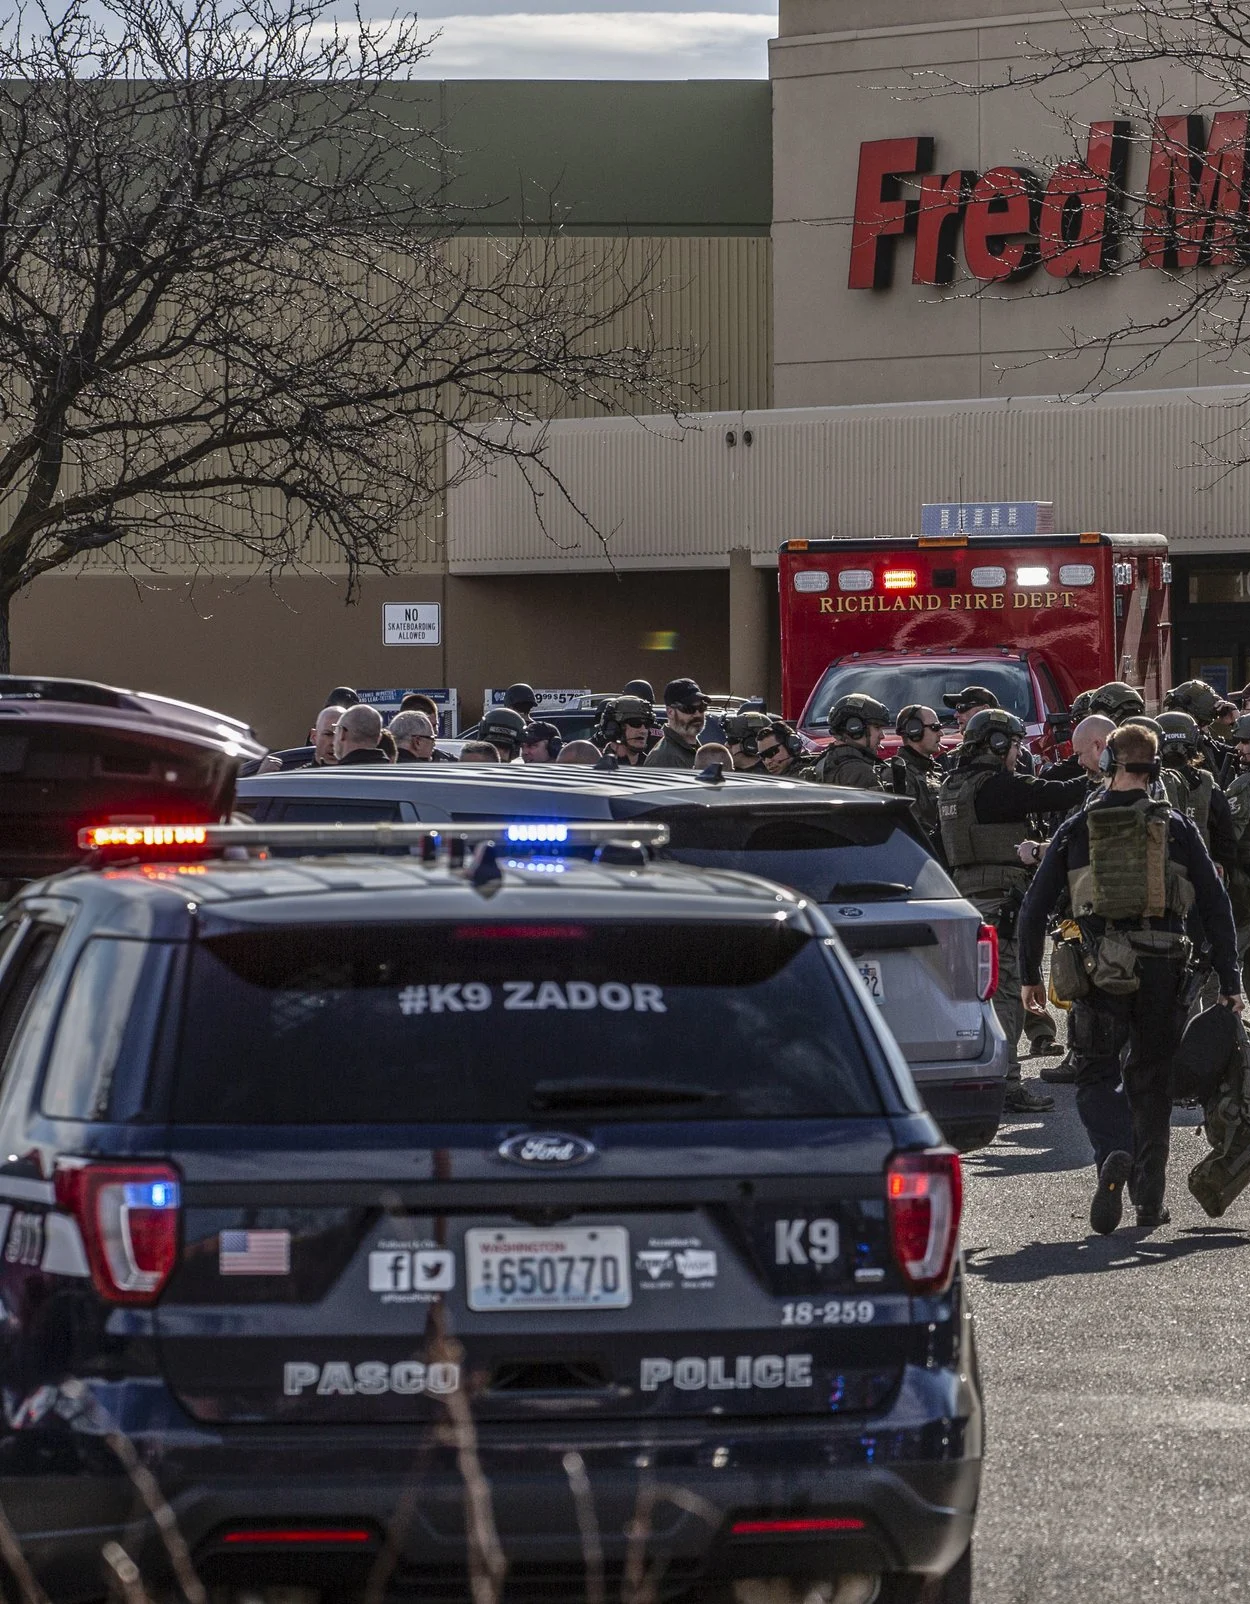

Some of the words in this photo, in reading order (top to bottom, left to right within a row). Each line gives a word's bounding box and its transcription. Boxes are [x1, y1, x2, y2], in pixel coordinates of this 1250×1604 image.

[848, 119, 1116, 290] Fred
[405, 608, 418, 621] NO
[819, 595, 942, 613] RICHLAND
[949, 593, 1005, 610] FIRE
[1013, 592, 1078, 609] DEPT.
[387, 622, 436, 631] SKATEBOARDING
[398, 631, 426, 640] ALLOWED
[398, 982, 492, 1015] #K9
[502, 981, 668, 1013] ZADOR
[521, 1138, 575, 1161] Ford
[479, 1241, 566, 1254] WASHINGTON
[775, 1218, 840, 1265] K9
[498, 1255, 620, 1295] 650770
[781, 1300, 875, 1326] 18-259
[283, 1360, 461, 1396] PASCO
[640, 1354, 813, 1390] POLICE
